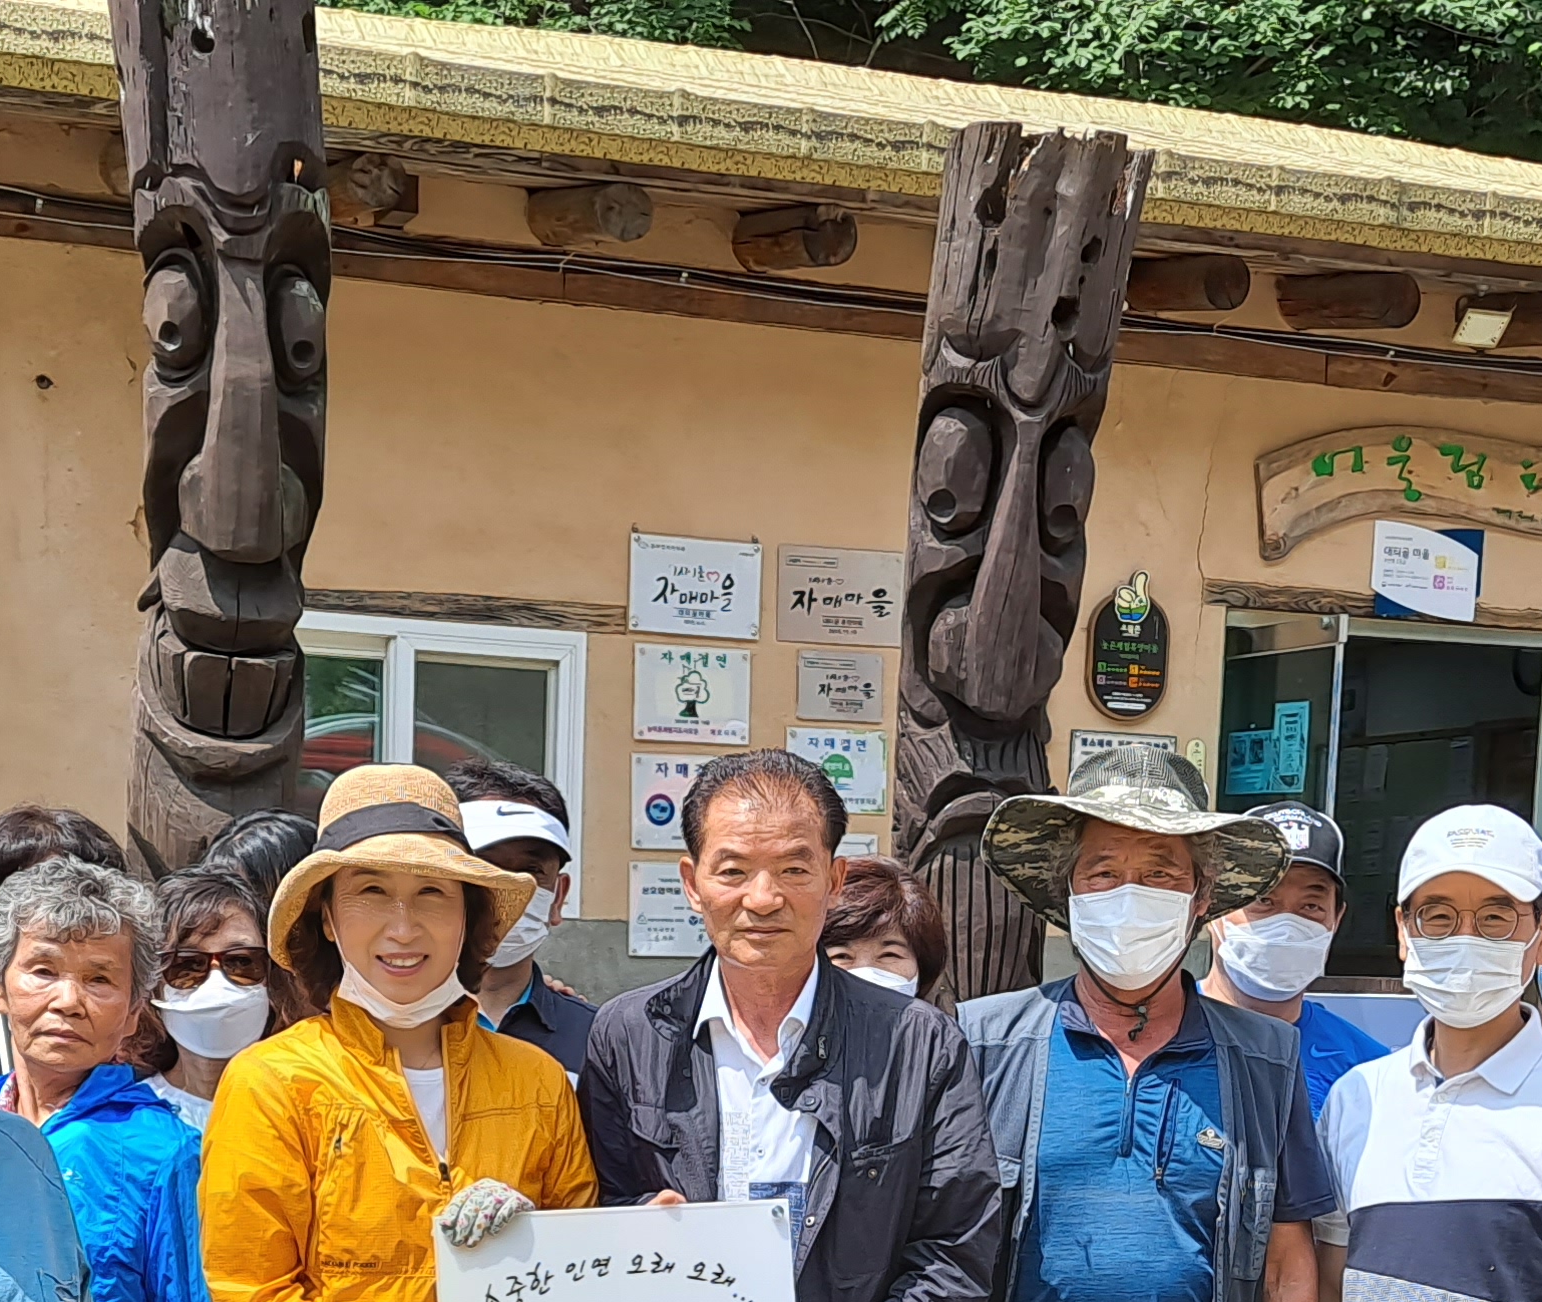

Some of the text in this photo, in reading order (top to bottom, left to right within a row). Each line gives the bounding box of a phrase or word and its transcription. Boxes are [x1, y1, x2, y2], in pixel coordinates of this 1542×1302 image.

[651, 573, 735, 612] 자매마을
[564, 1255, 612, 1284] 인연
[625, 1251, 675, 1276] 오래
